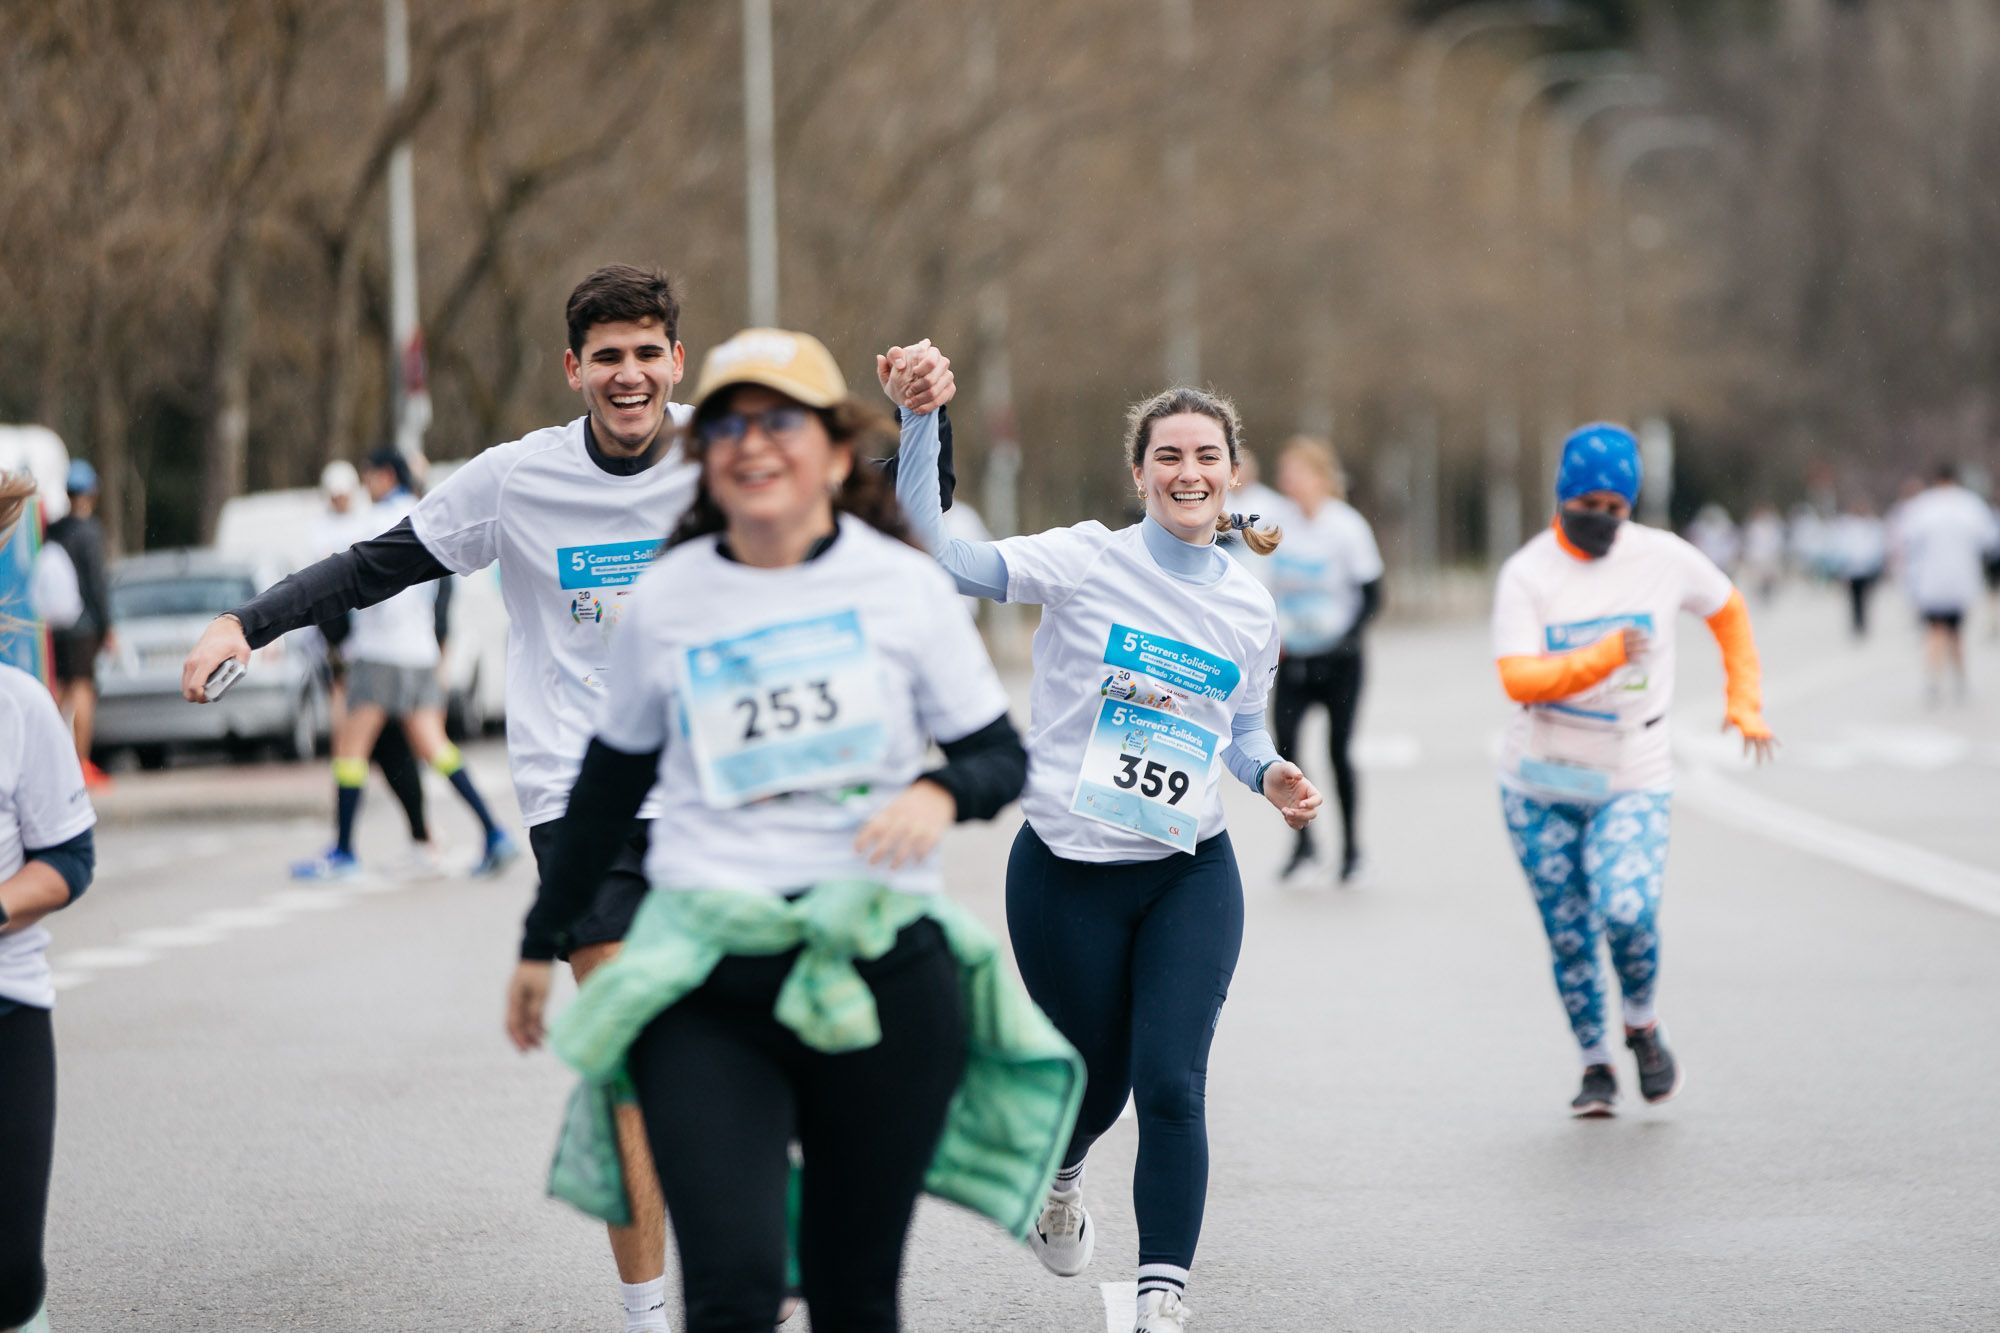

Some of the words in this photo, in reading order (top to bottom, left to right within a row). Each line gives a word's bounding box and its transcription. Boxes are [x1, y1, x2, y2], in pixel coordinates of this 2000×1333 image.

[588, 553, 631, 564] Carrera
[578, 591, 590, 600] 20
[1119, 670, 1131, 681] 20
[1140, 640, 1179, 660] Carrera
[1181, 653, 1221, 676] Solidaria
[1146, 664, 1168, 679] Sábado
[1168, 673, 1174, 681] 7
[1174, 675, 1183, 684] de
[1182, 680, 1203, 693] marzo
[1202, 685, 1228, 702] 2026
[735, 680, 839, 739] 253
[1128, 713, 1168, 733] Carrera
[1170, 726, 1203, 748] Solidaria
[1113, 753, 1190, 806] 359
